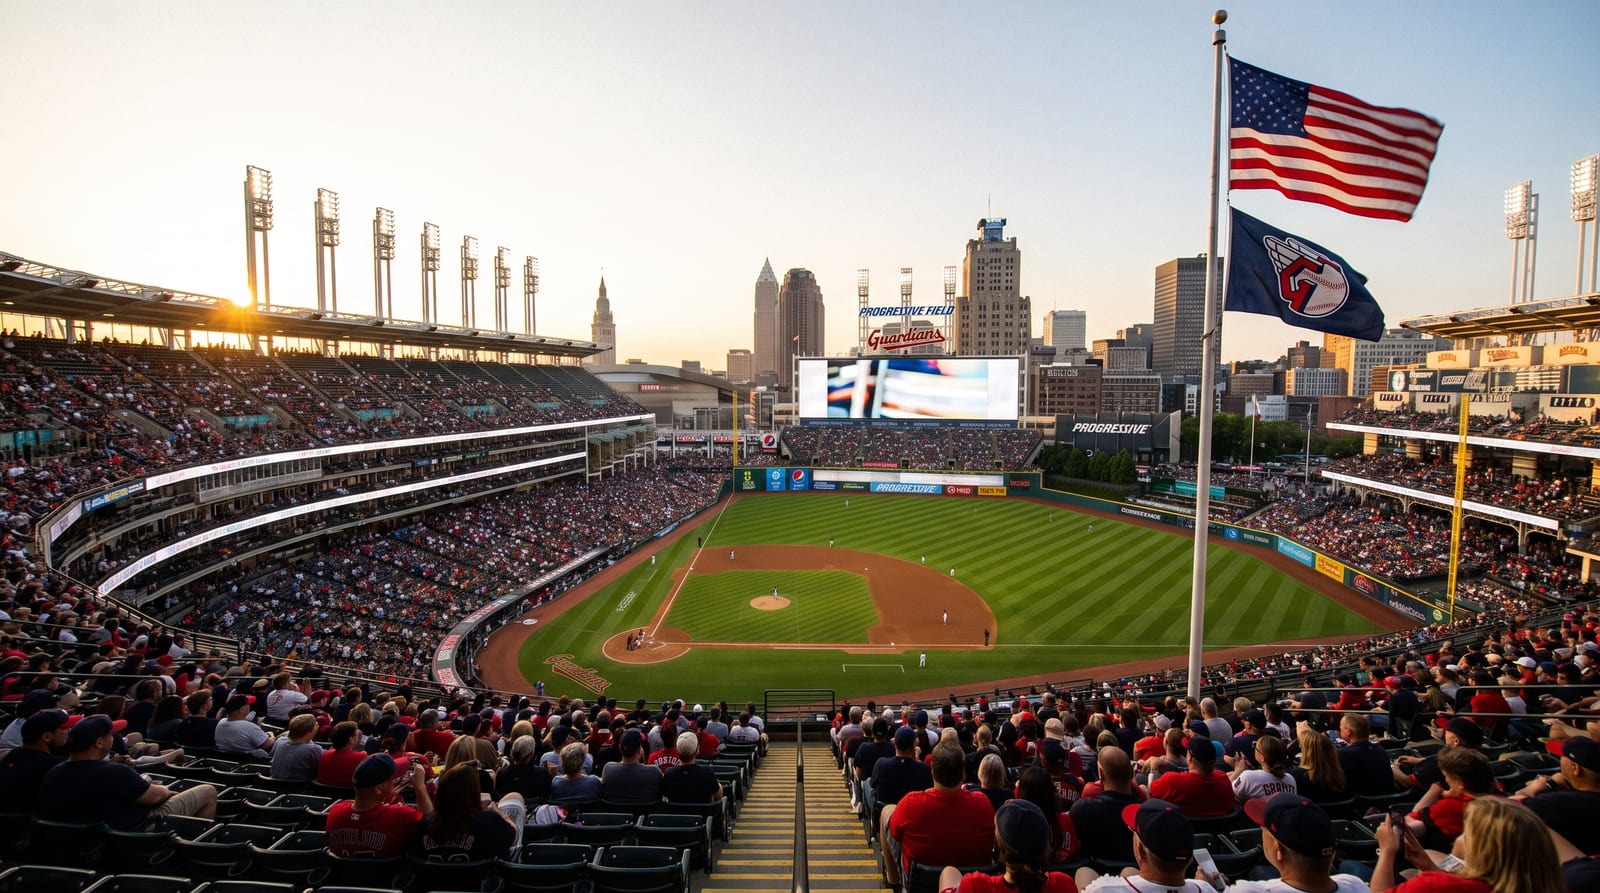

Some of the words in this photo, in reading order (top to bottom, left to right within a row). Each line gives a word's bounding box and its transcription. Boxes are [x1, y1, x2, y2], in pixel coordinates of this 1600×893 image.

[859, 306, 925, 316] PROGRESSIVE
[926, 305, 955, 315] FIELD
[868, 327, 946, 351] Guardians
[1072, 423, 1149, 434] PROGRESSIVE
[876, 483, 936, 494] PROGRESSIVE
